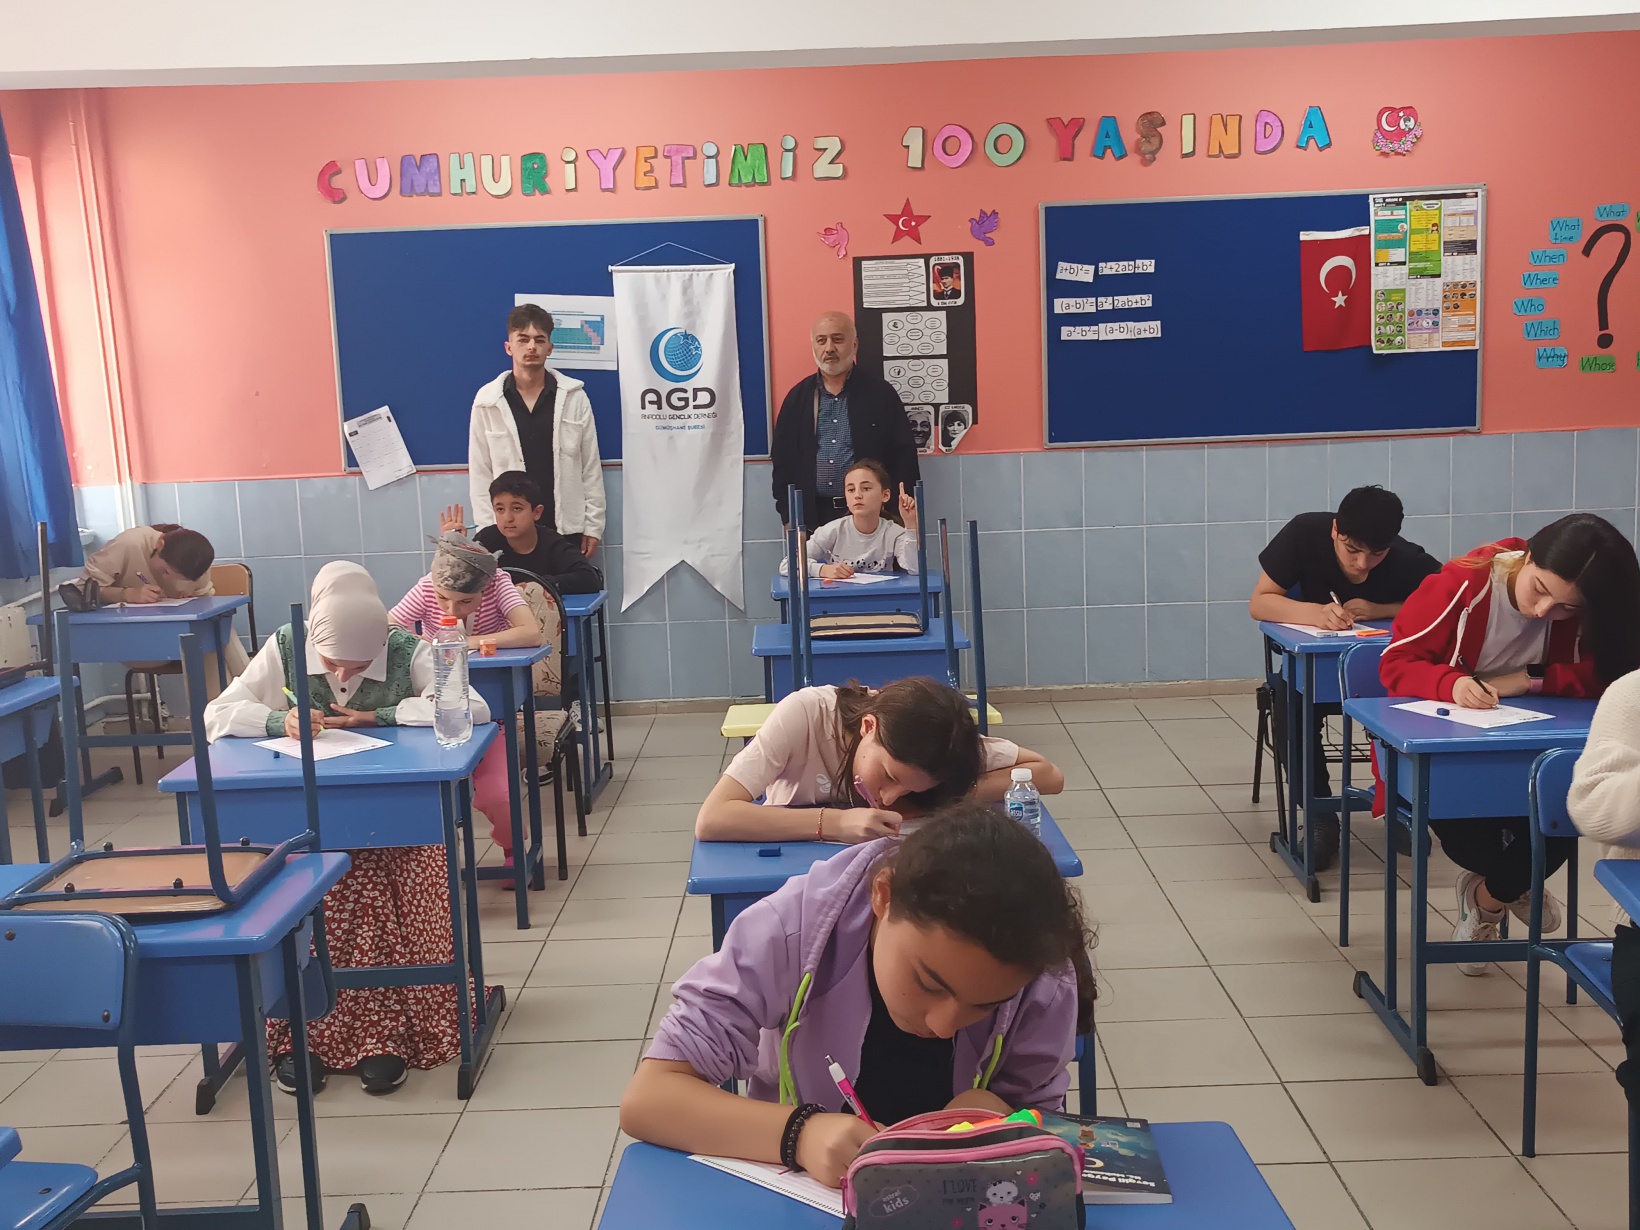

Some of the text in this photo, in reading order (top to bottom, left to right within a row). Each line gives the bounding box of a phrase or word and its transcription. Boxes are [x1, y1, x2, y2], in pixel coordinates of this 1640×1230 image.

[901, 122, 1026, 169] 100
[1046, 105, 1332, 167] YAŞINDA
[1597, 204, 1627, 218] What
[1550, 217, 1581, 232] What
[1530, 249, 1566, 264] When
[1522, 272, 1560, 286] Where
[1513, 298, 1545, 314] Who
[1524, 321, 1560, 338] Which
[1537, 347, 1568, 367] Why
[1580, 356, 1616, 371] Whose
[640, 387, 717, 411] AGD
[882, 1196, 910, 1214] kids
